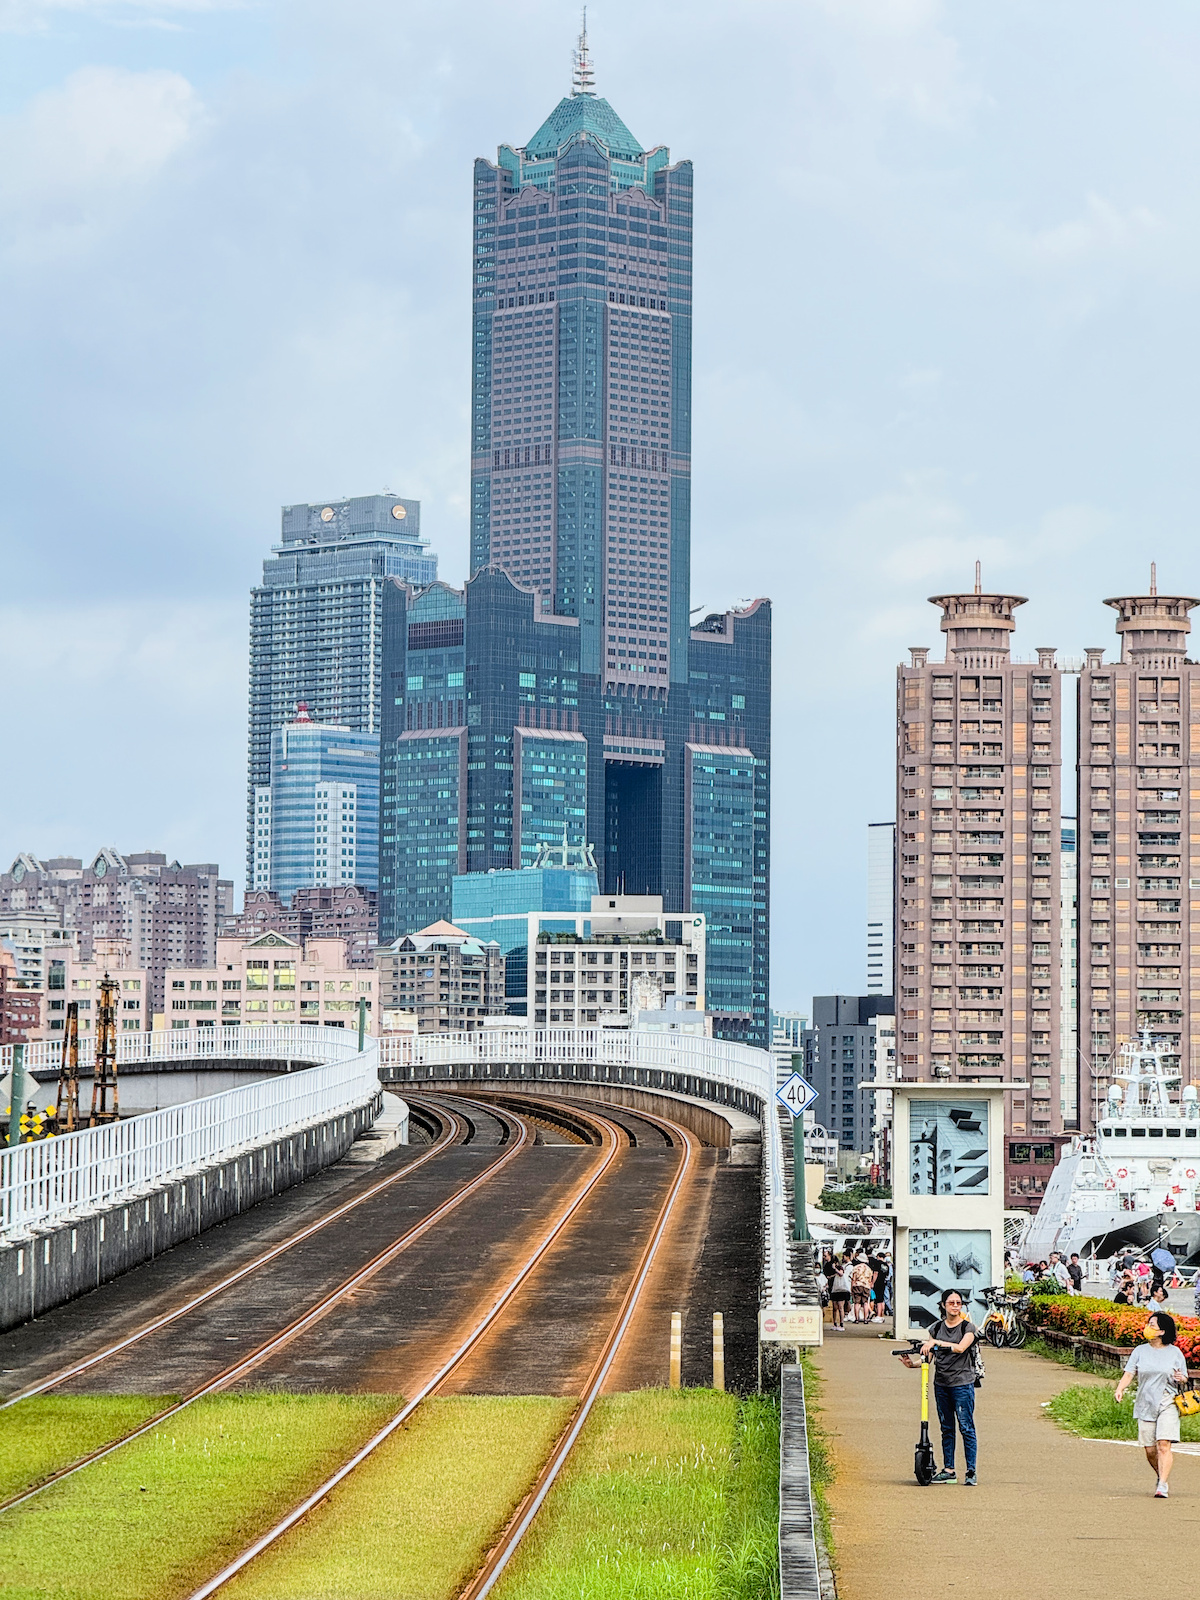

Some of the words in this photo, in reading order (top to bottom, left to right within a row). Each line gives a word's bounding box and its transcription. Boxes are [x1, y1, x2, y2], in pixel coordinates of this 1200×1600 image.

[787, 1084, 806, 1104] 40
[780, 1316, 813, 1324] 禁止通行
